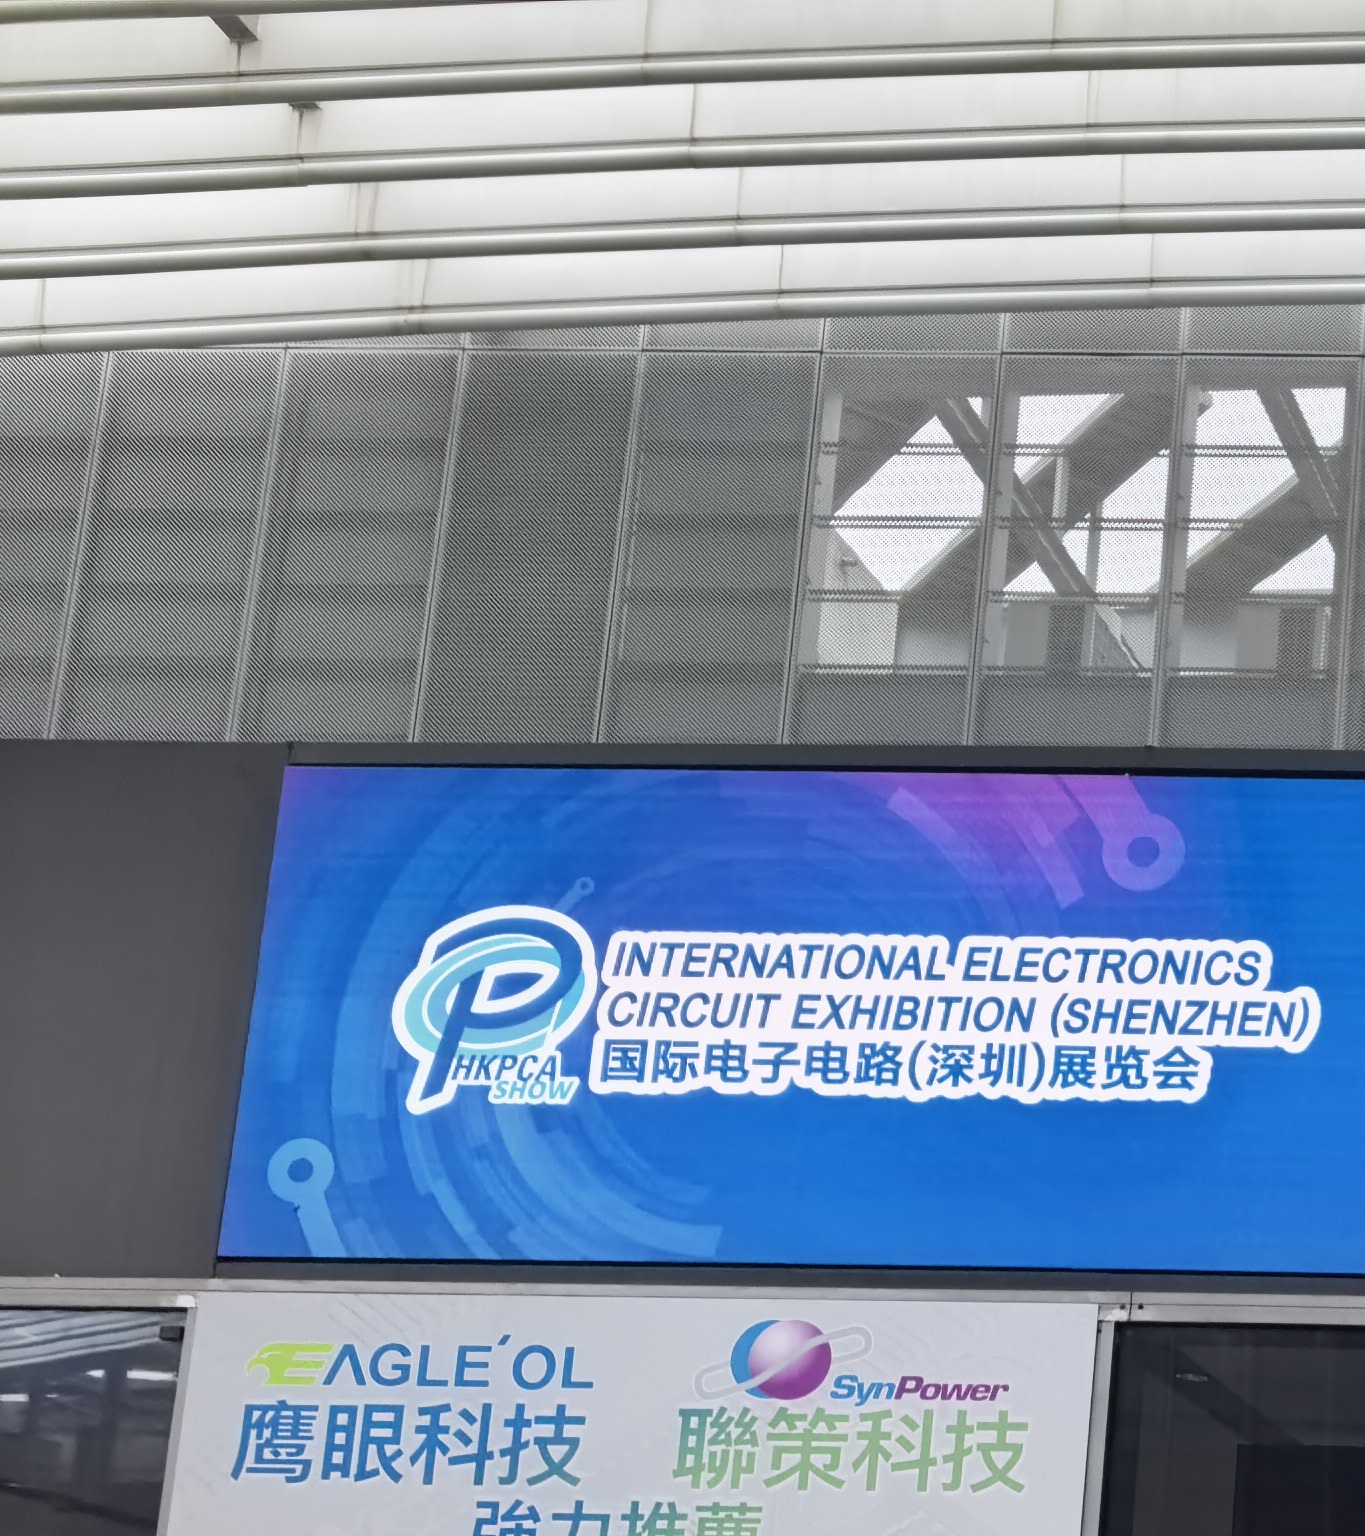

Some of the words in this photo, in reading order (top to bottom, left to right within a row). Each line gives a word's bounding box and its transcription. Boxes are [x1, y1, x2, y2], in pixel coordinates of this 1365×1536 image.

[610, 941, 947, 982] INTERNATIONAL
[962, 945, 1263, 987] ELECTRONICS
[606, 990, 784, 1030] CIRCUIT
[792, 992, 1034, 1035] EXHIBITION
[1049, 993, 1309, 1041] (SHENZHEN)
[451, 1054, 557, 1082] HKPCA
[598, 1040, 1202, 1091] 国际电子电路(深圳)展览会
[493, 1080, 574, 1100] SHOW
[830, 1373, 1010, 1404] SynPower
[230, 1399, 582, 1486] 鹰眼科技
[673, 1405, 1028, 1494] 聯策科技
